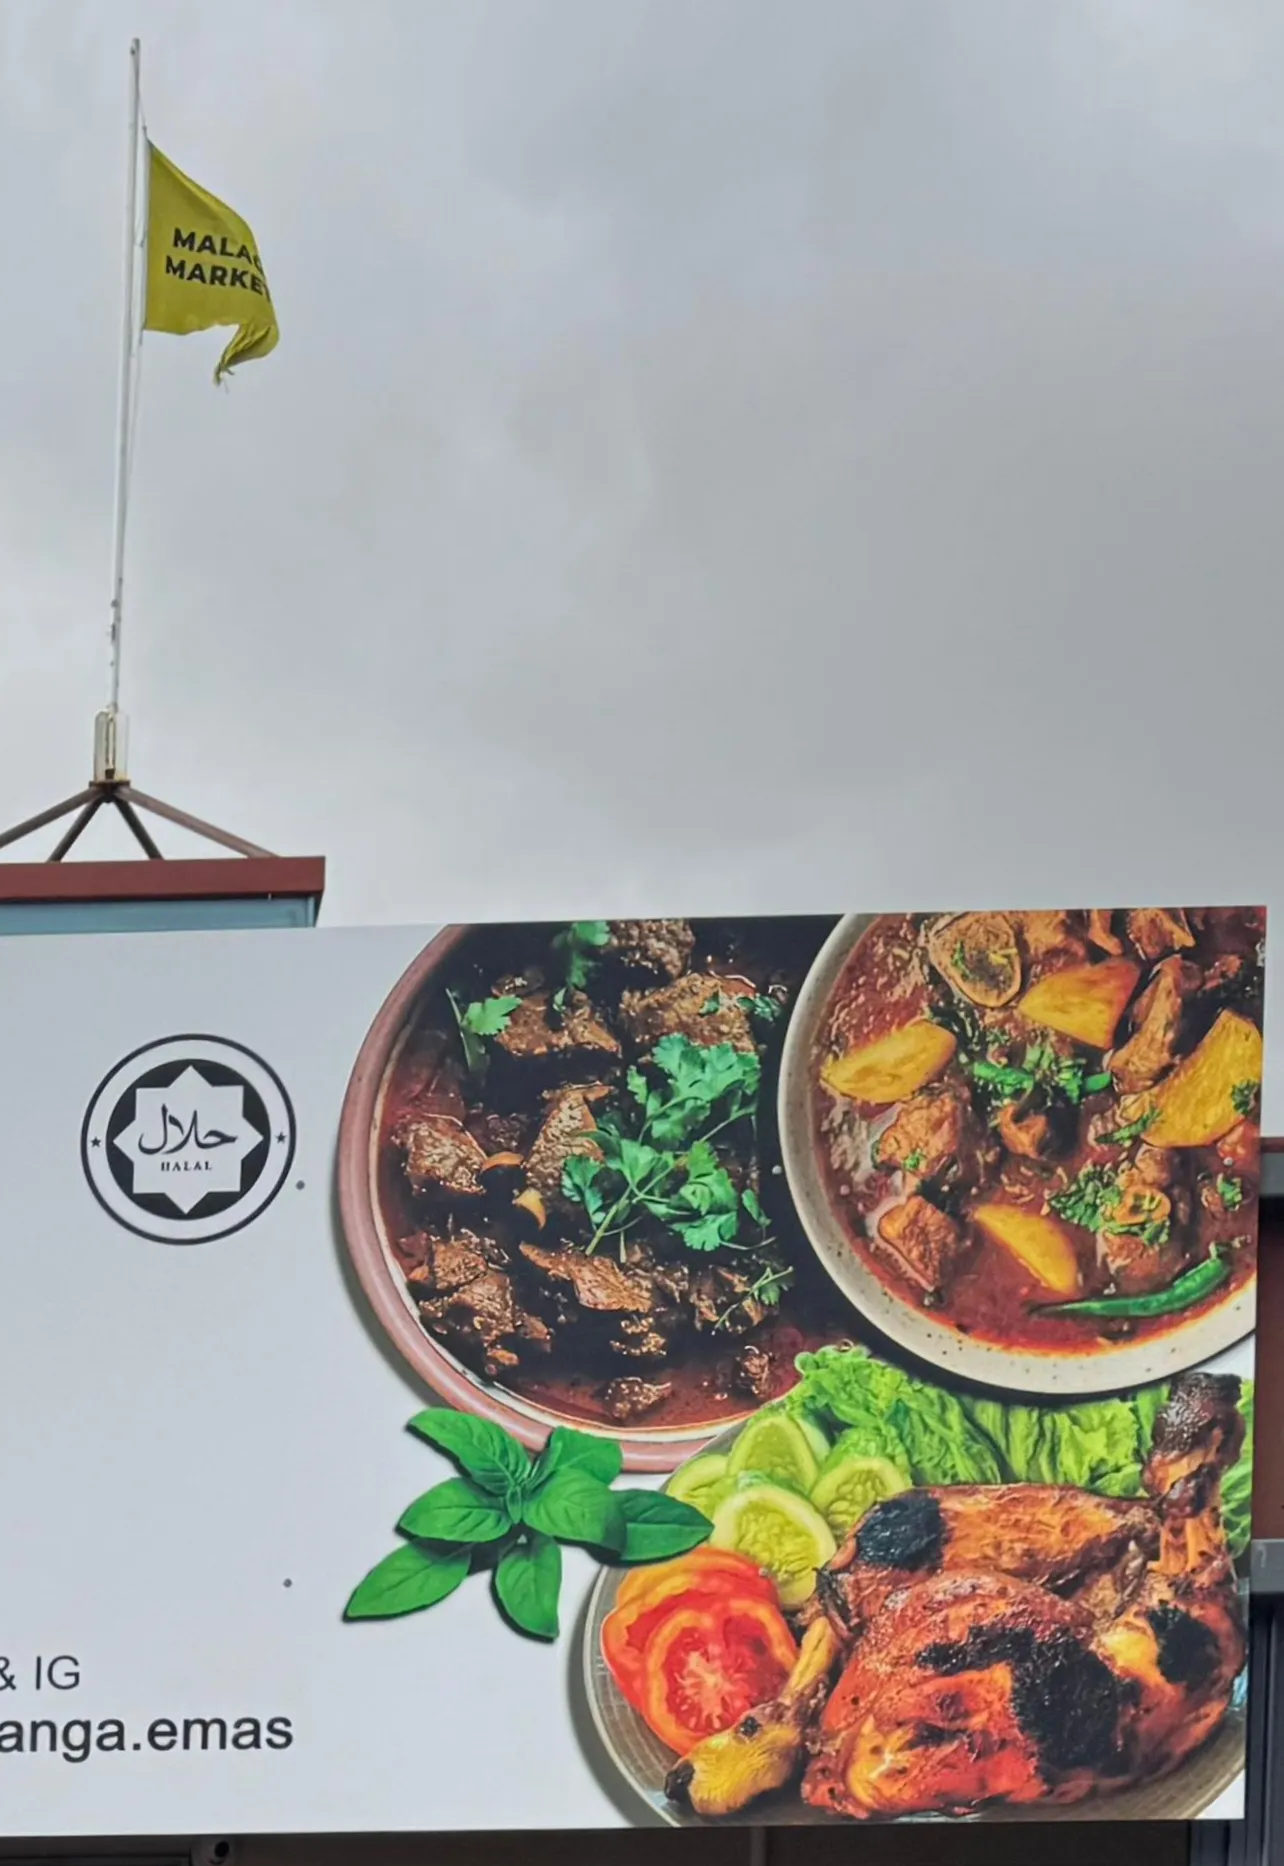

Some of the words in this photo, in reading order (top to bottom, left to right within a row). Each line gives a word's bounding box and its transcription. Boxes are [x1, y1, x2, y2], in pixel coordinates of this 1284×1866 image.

[137, 1103, 239, 1155] حلال
[160, 1161, 213, 1173] HALAL
[32, 1653, 82, 1692] IG
